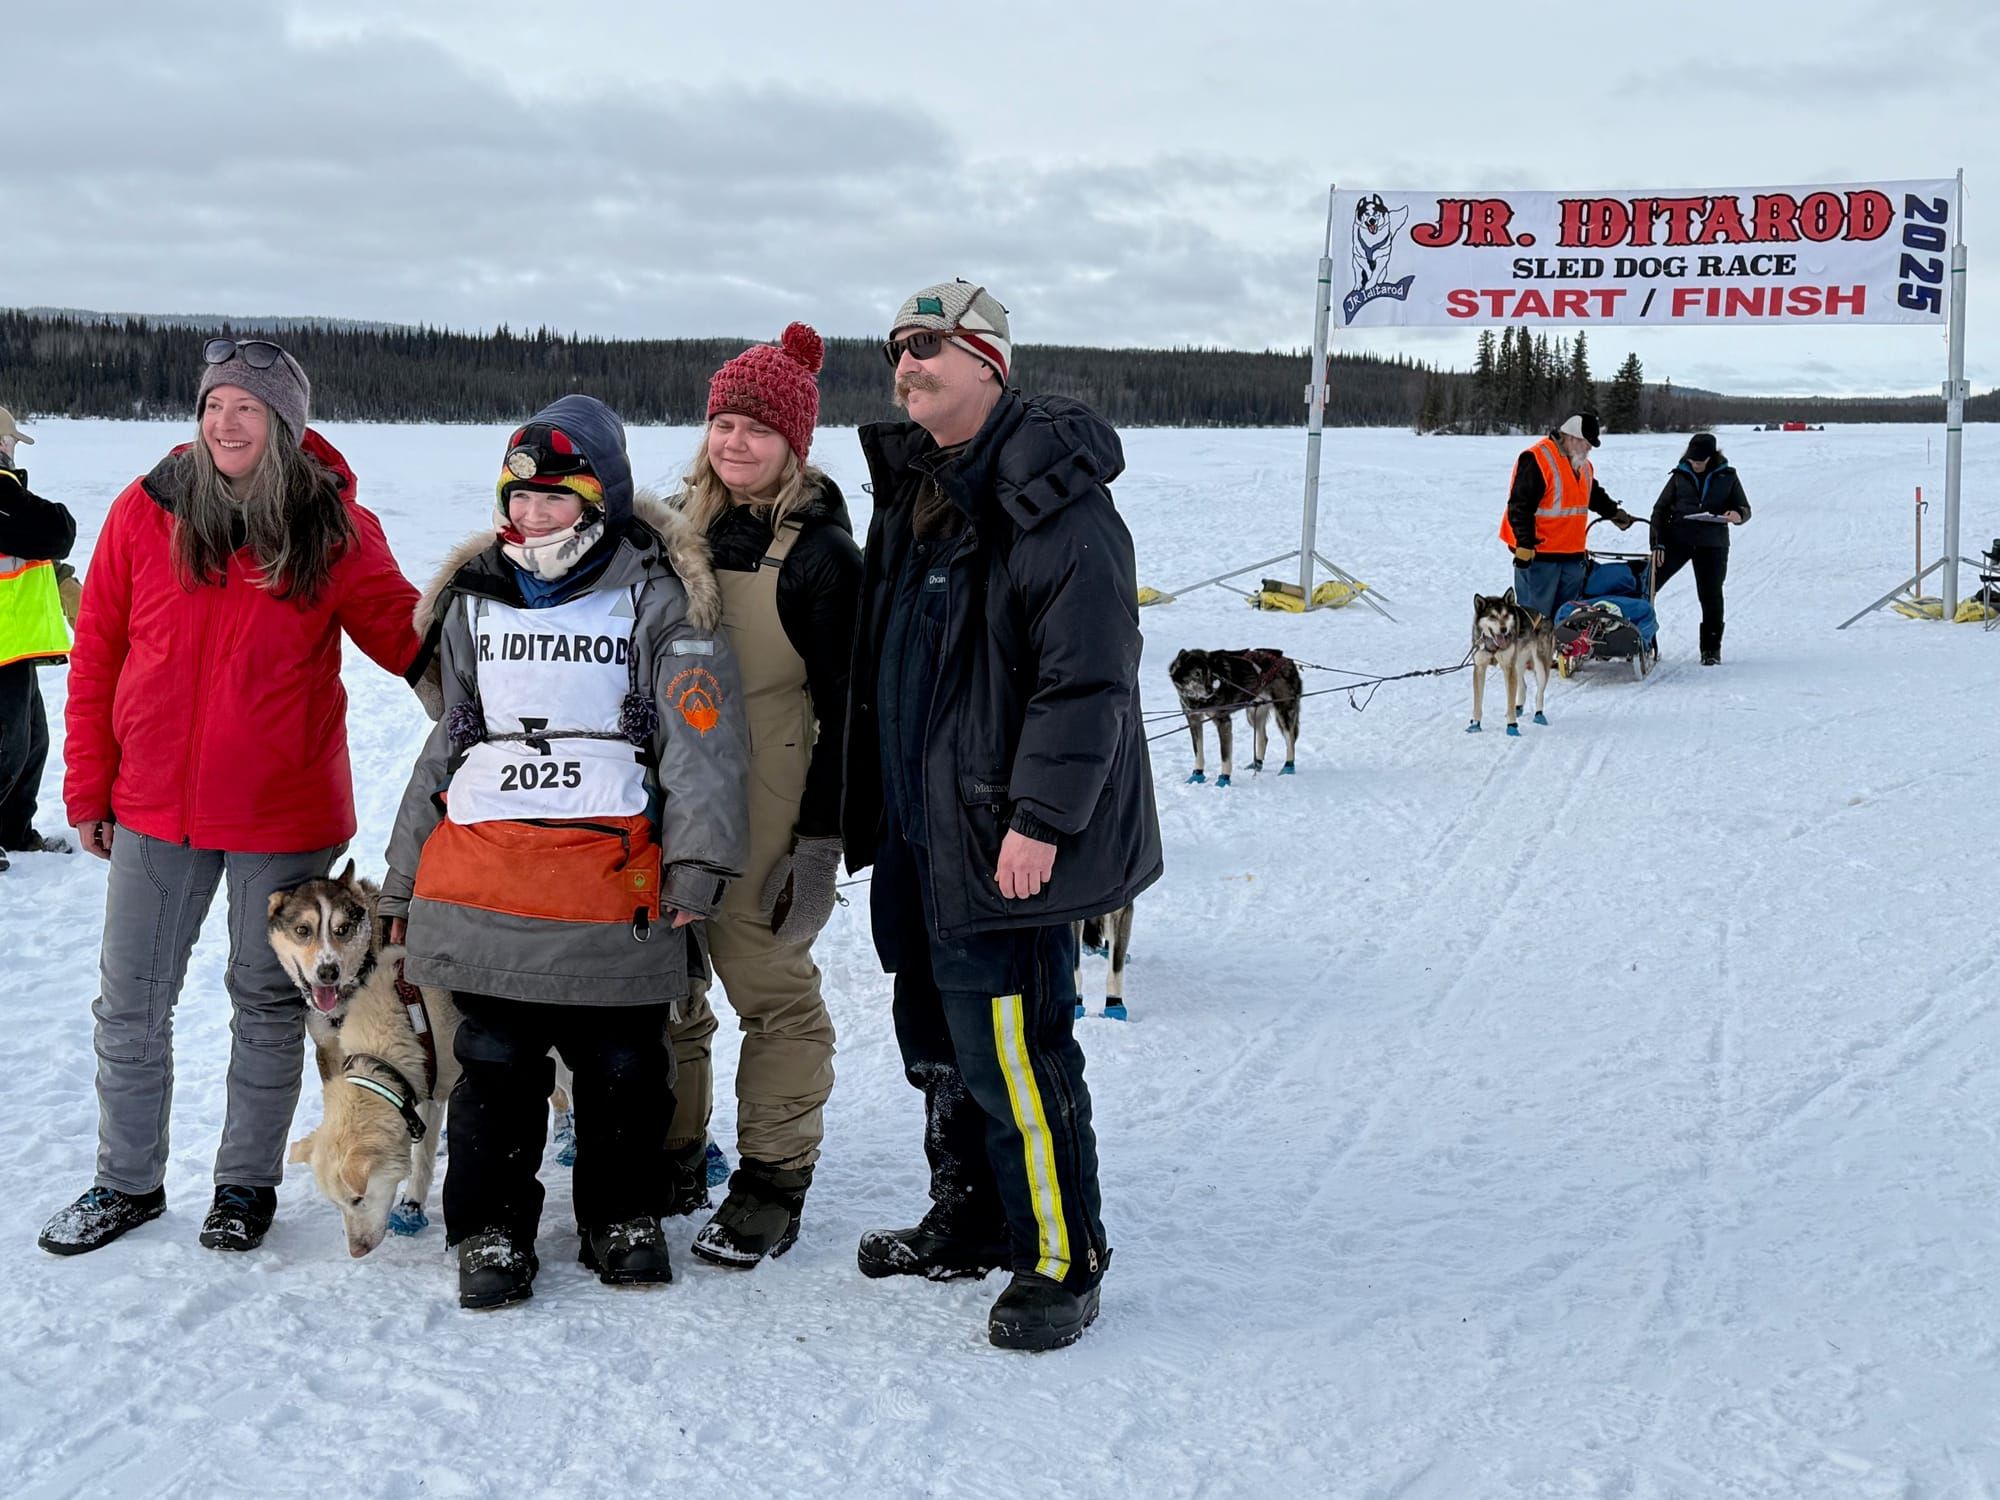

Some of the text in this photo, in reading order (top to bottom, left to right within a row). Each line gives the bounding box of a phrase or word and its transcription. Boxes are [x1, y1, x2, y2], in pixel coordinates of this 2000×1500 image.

[1410, 189, 1896, 248] JR. IDITAROD
[1512, 253, 1797, 280] SLED DOG RACE
[1897, 193, 1949, 314] 2025
[1346, 284, 1404, 313] JR Iditarod
[1446, 284, 1866, 318] START / FINISH
[477, 633, 629, 666] R. IDITAROD
[500, 761, 582, 792] 2025
